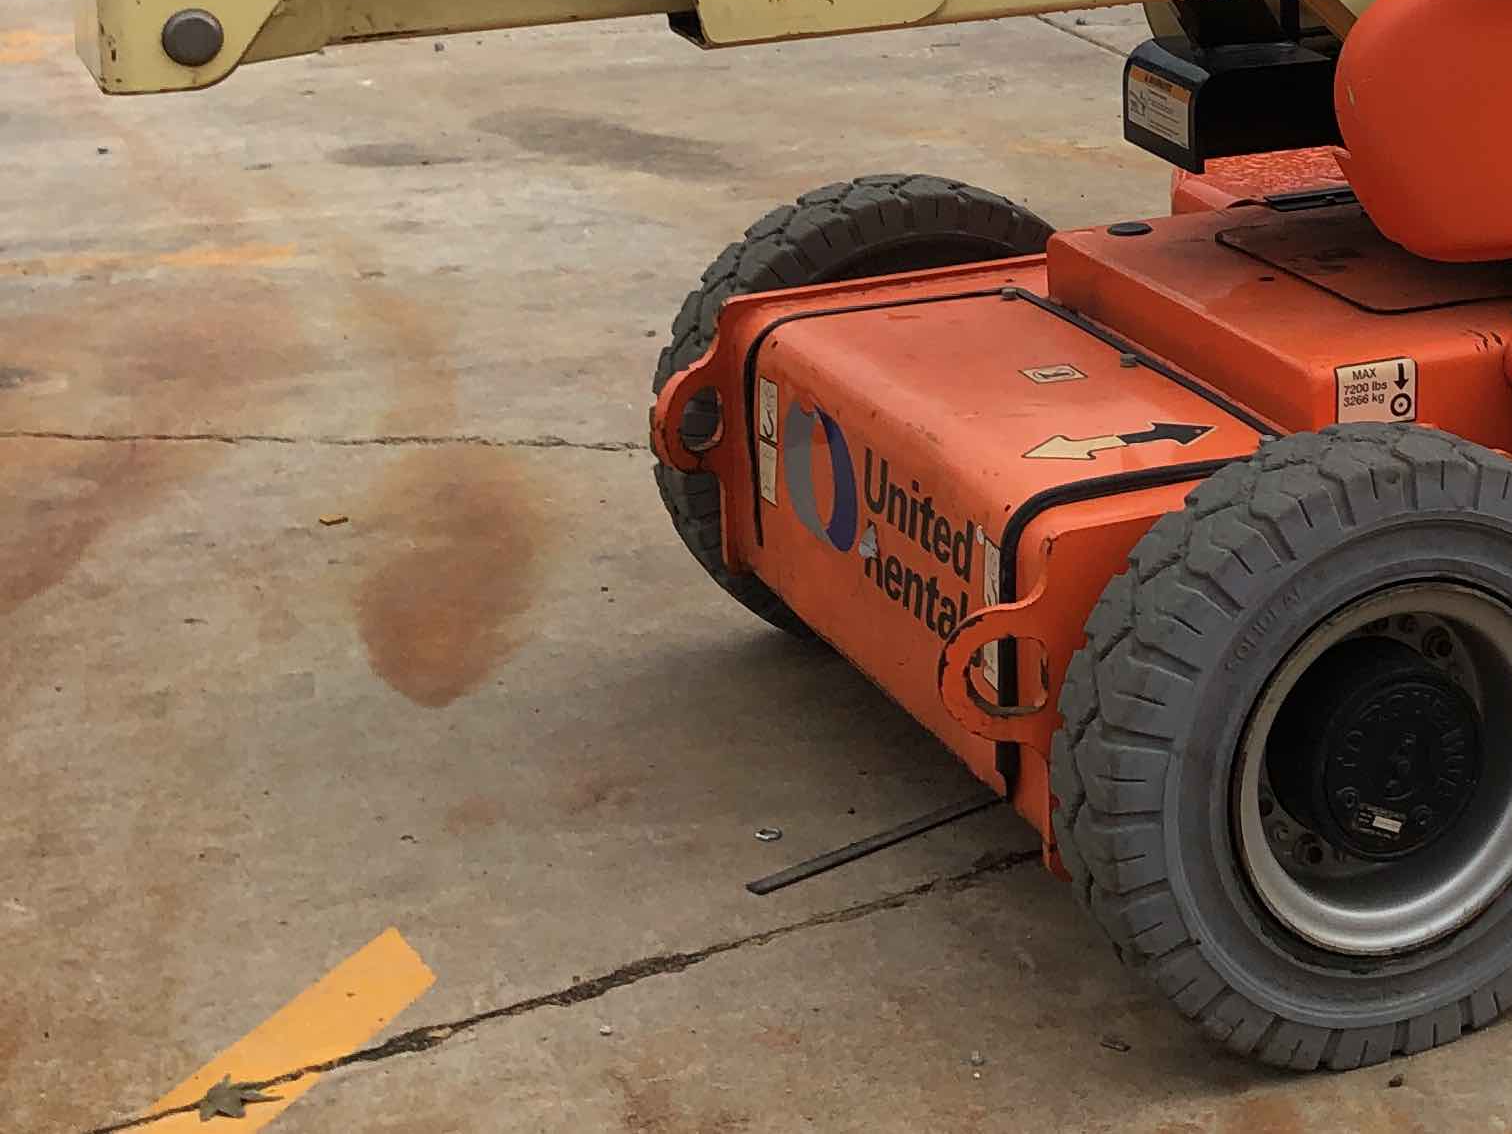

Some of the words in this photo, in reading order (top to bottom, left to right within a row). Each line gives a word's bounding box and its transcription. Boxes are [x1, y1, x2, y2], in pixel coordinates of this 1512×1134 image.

[1352, 368, 1377, 380] MAX
[1343, 383, 1369, 395] 7200
[1372, 381, 1388, 391] lbs
[1343, 395, 1369, 407] 3266
[1372, 393, 1385, 404] kg
[864, 446, 974, 583] United
